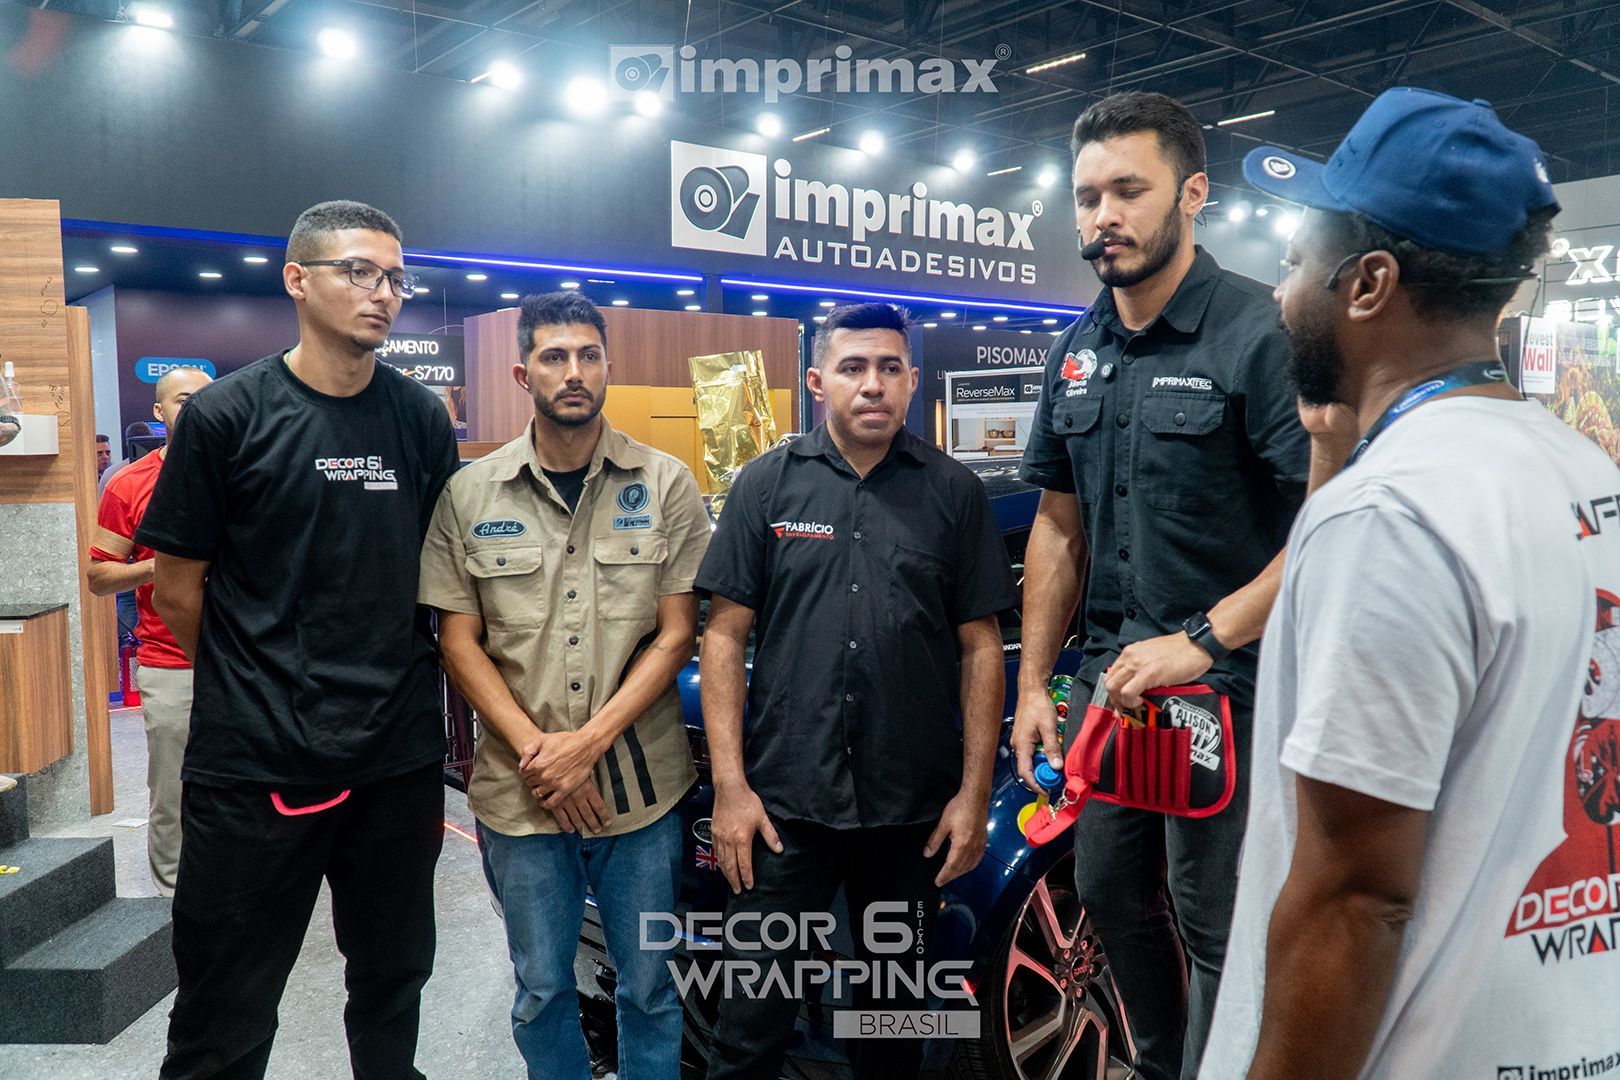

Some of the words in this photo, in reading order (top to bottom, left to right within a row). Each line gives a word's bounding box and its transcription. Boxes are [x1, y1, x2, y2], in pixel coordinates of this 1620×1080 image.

[774, 236, 1036, 284] AUTOADESIVOS
[977, 346, 1047, 365] PISOMAX
[1524, 347, 1553, 371] Wall
[414, 365, 454, 381] S7170
[956, 386, 1016, 398] ReverseMax
[315, 458, 365, 470] DECOR
[324, 469, 397, 481] WRAPPING
[786, 522, 833, 534] FABRÍCIO
